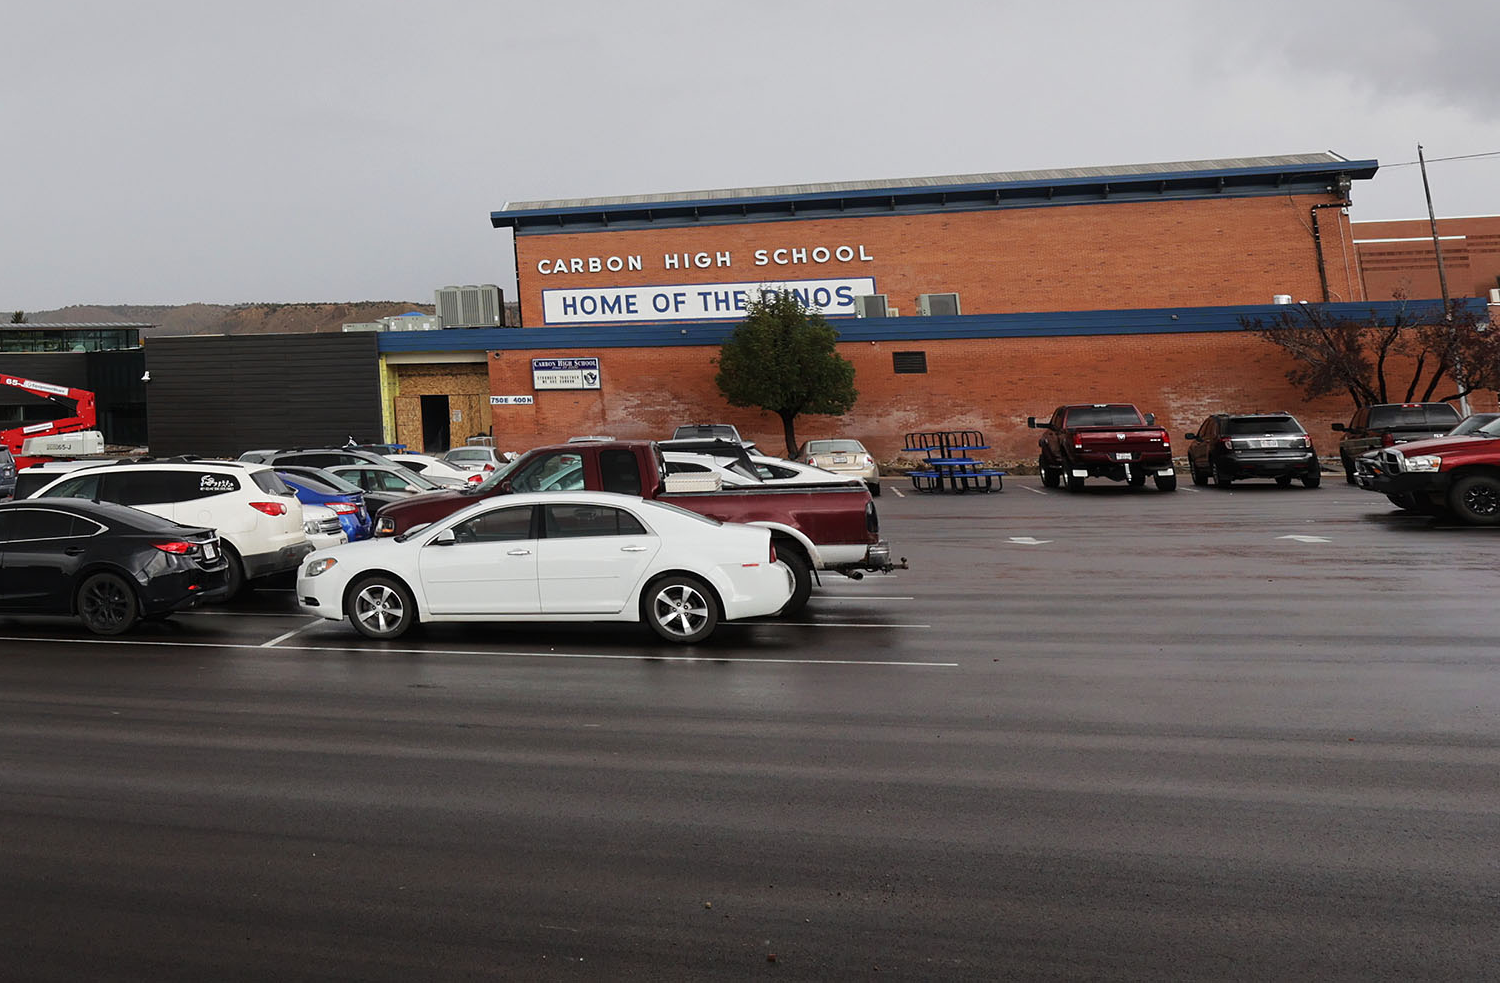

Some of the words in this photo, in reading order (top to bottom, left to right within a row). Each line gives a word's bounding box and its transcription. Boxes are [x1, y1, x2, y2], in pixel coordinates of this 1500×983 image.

[536, 254, 643, 275] CARBON
[664, 250, 731, 270] HIGH
[754, 245, 874, 266] SCHOOL
[562, 293, 639, 317] HOME
[652, 292, 687, 313] OF
[697, 290, 747, 312] THE
[557, 359, 573, 367] HIGH
[574, 359, 596, 367] SCHOOL
[513, 396, 532, 404] 400N
